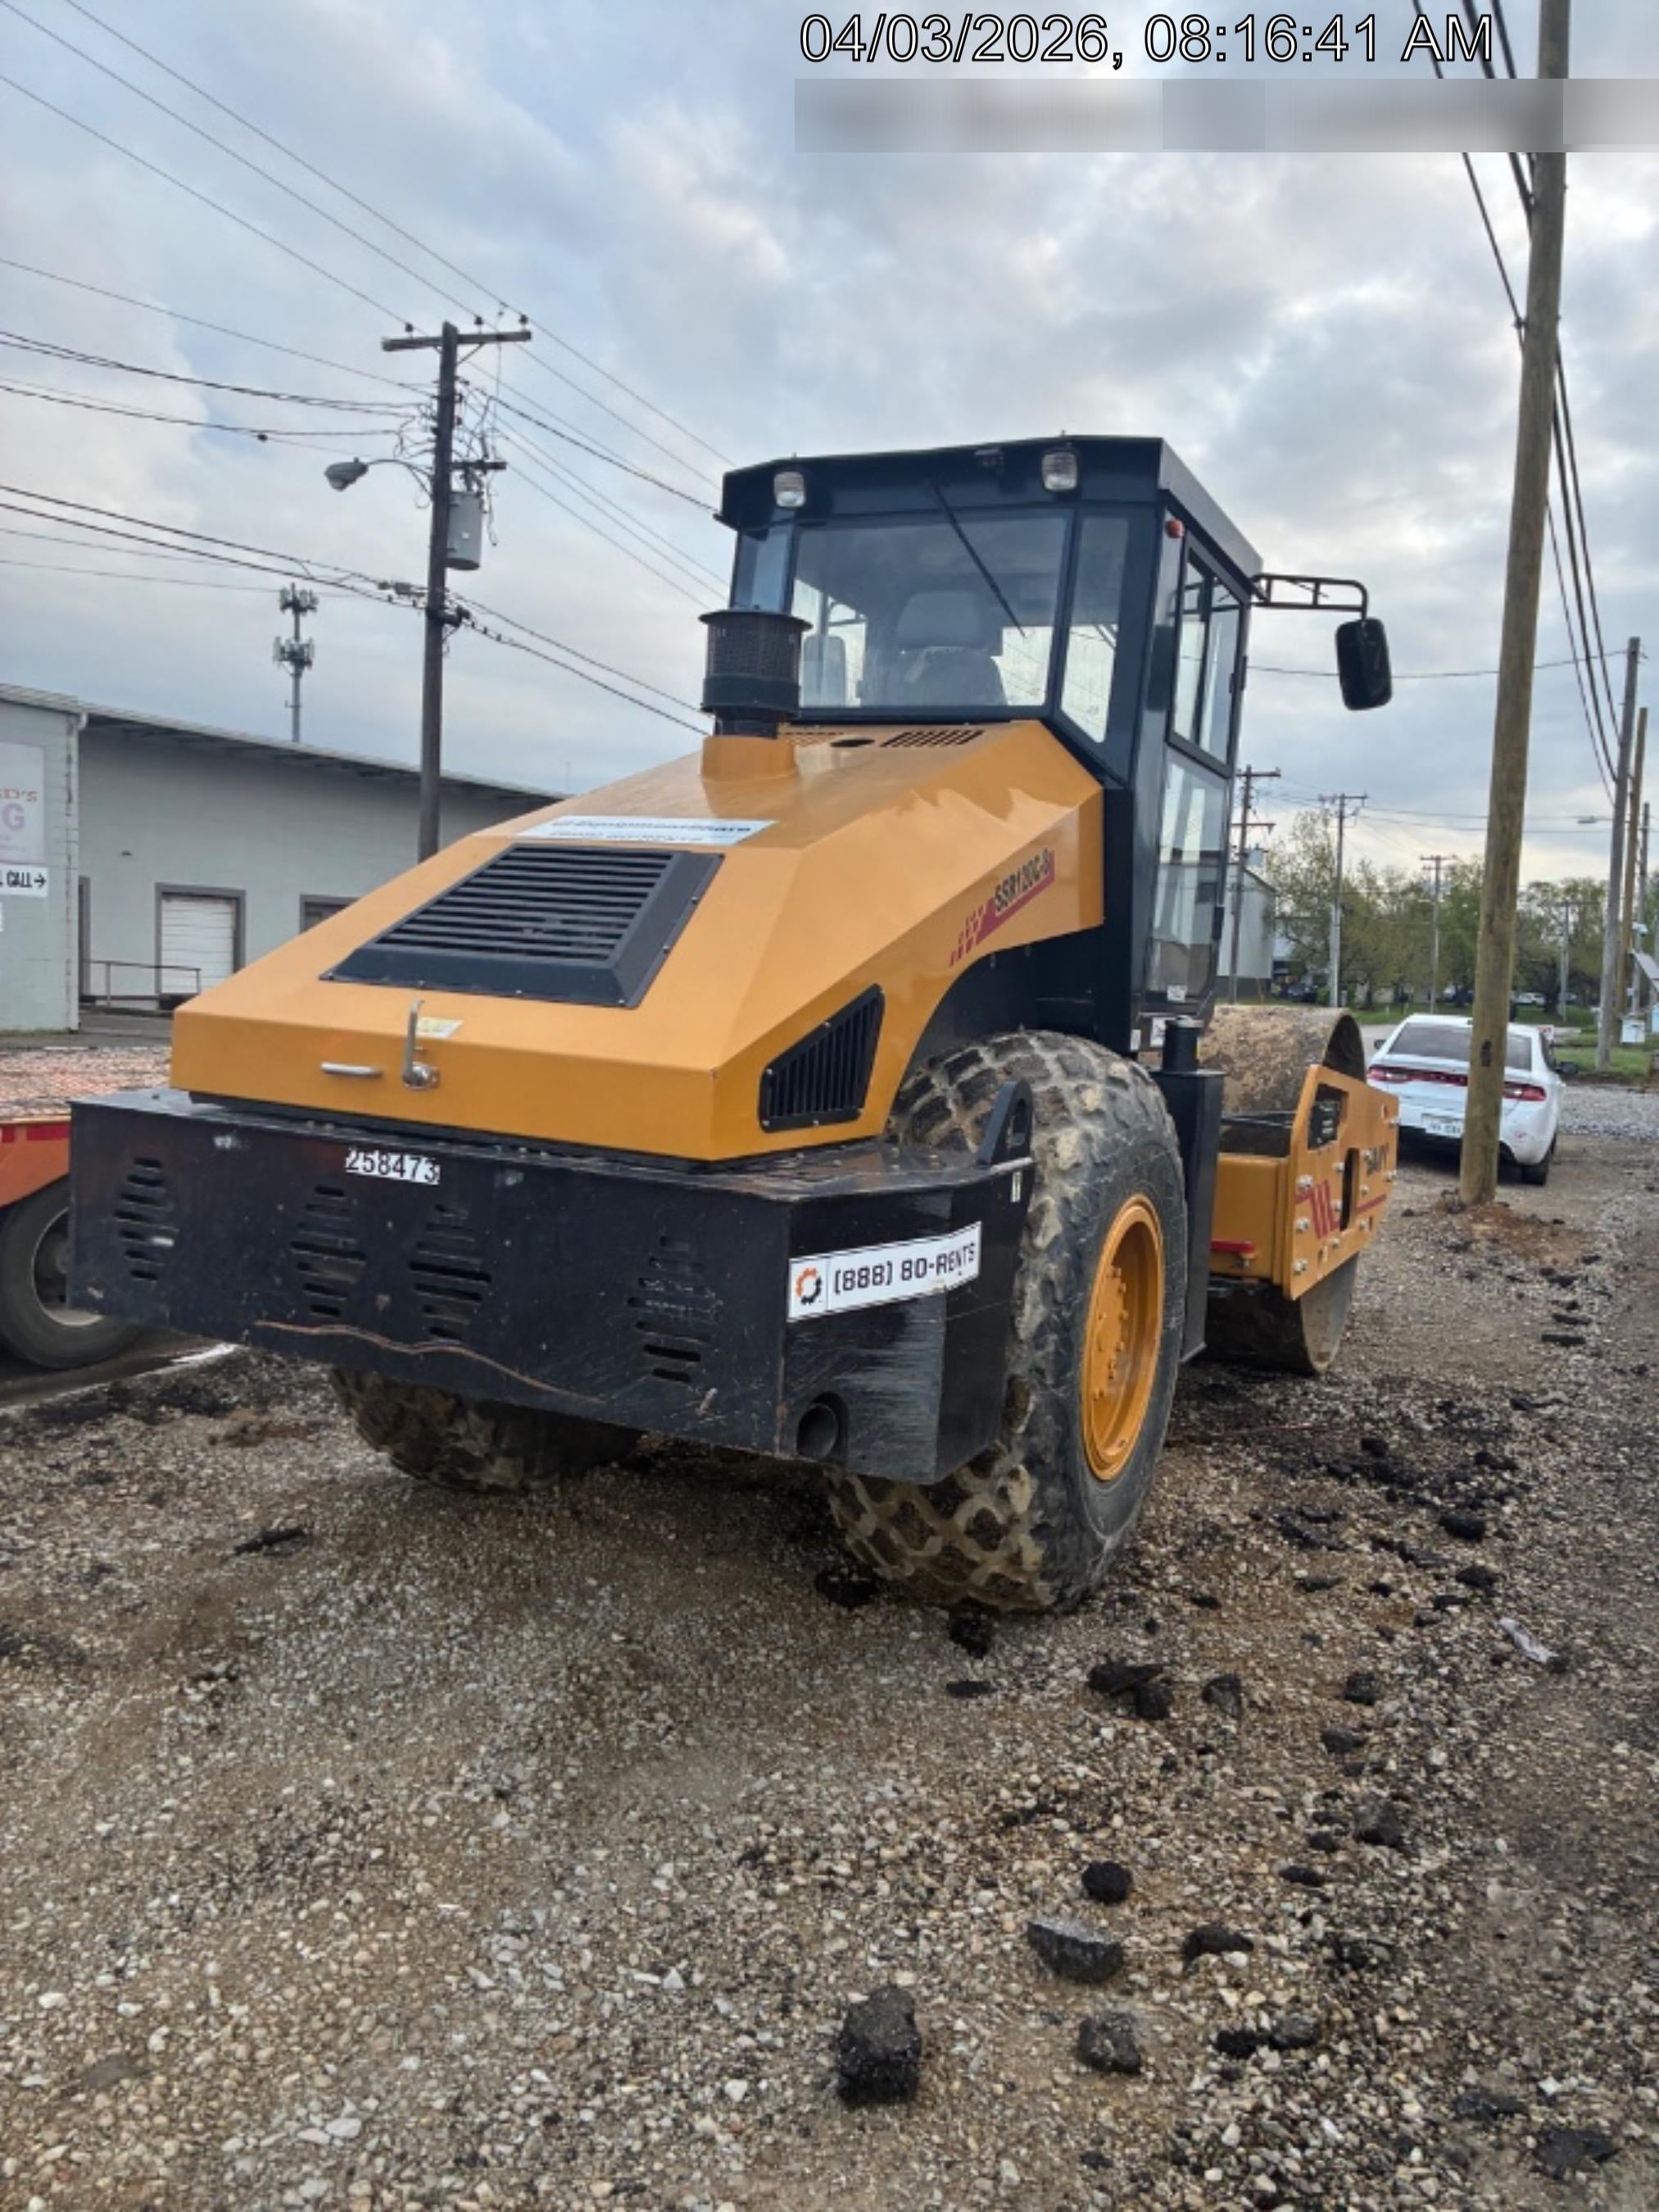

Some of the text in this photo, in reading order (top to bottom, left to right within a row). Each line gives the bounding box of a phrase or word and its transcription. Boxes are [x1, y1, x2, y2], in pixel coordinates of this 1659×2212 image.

[7, 870, 32, 887] CALL
[346, 1149, 437, 1181] 258473
[834, 1242, 976, 1294] (888) 80-RENTS
